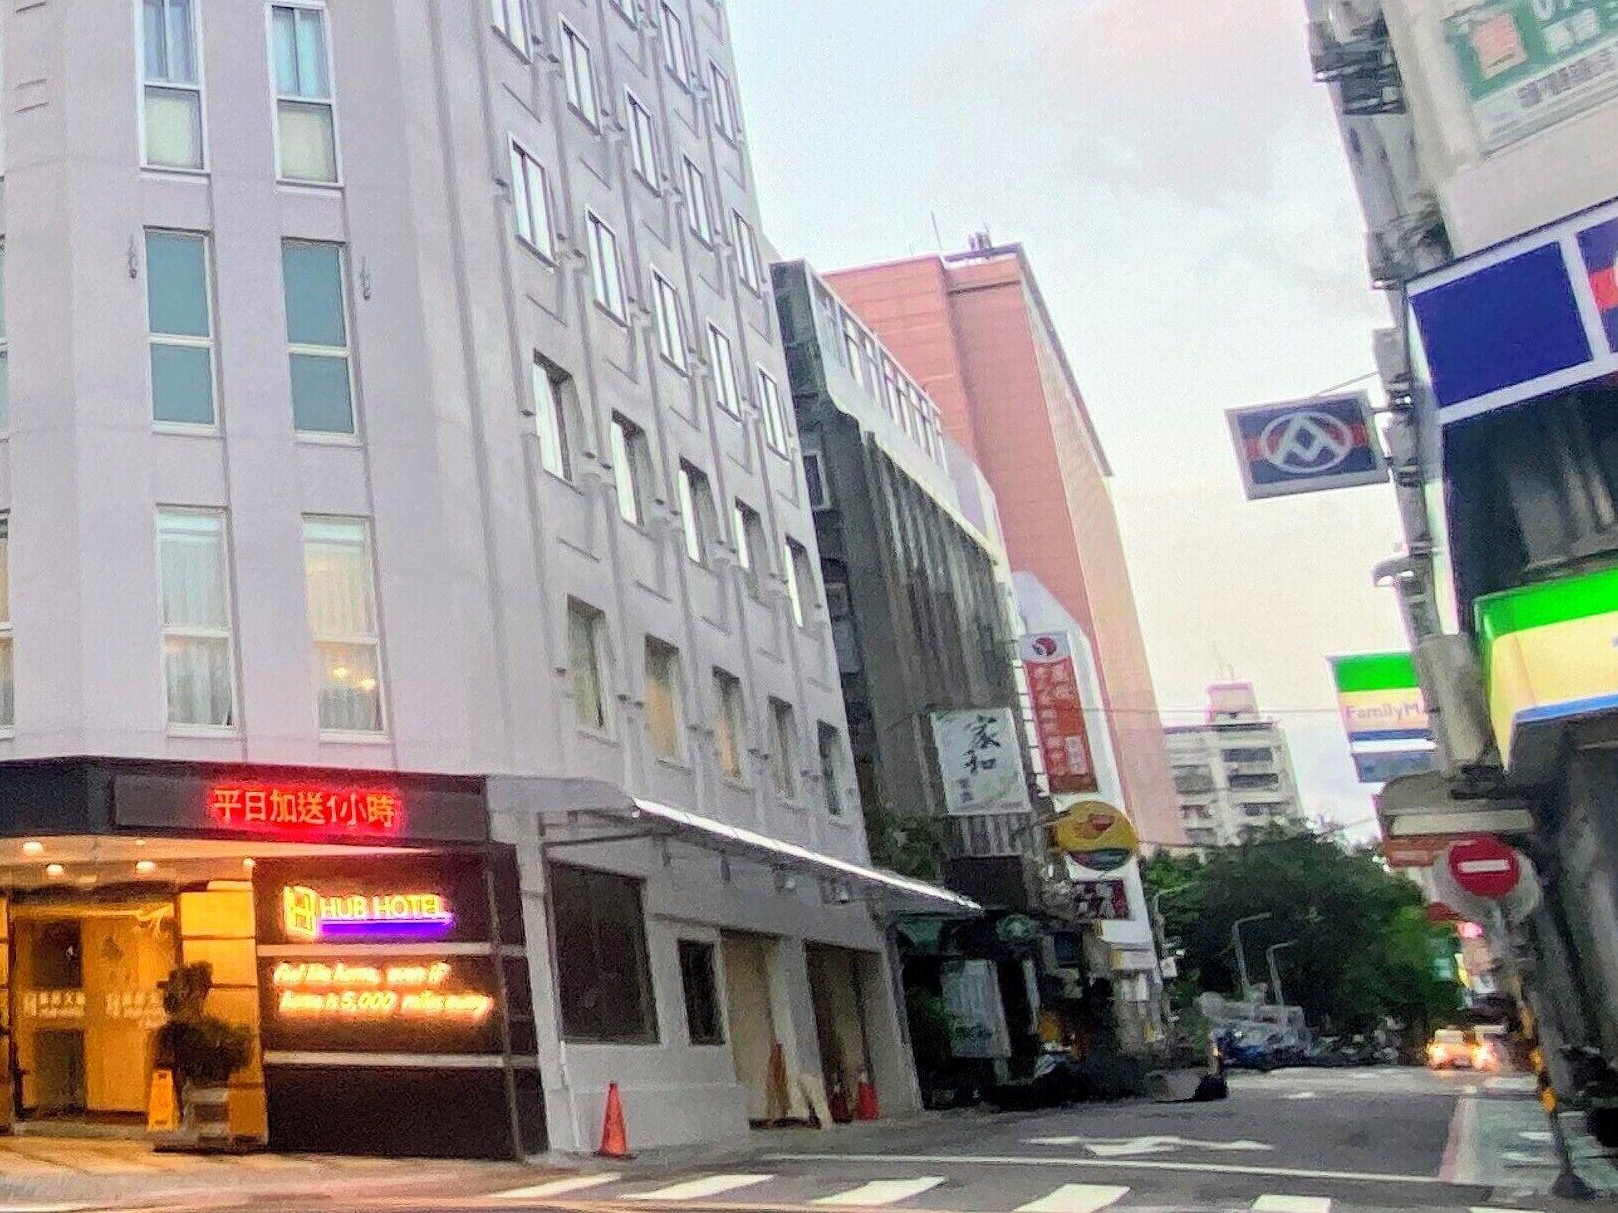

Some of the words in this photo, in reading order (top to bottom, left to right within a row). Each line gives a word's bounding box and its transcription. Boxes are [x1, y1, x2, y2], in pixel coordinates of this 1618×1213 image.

[1345, 702, 1419, 720] FamilyM
[212, 788, 398, 829] 平日加送1小時
[320, 895, 368, 919] HUB
[372, 893, 443, 918] HOTEL
